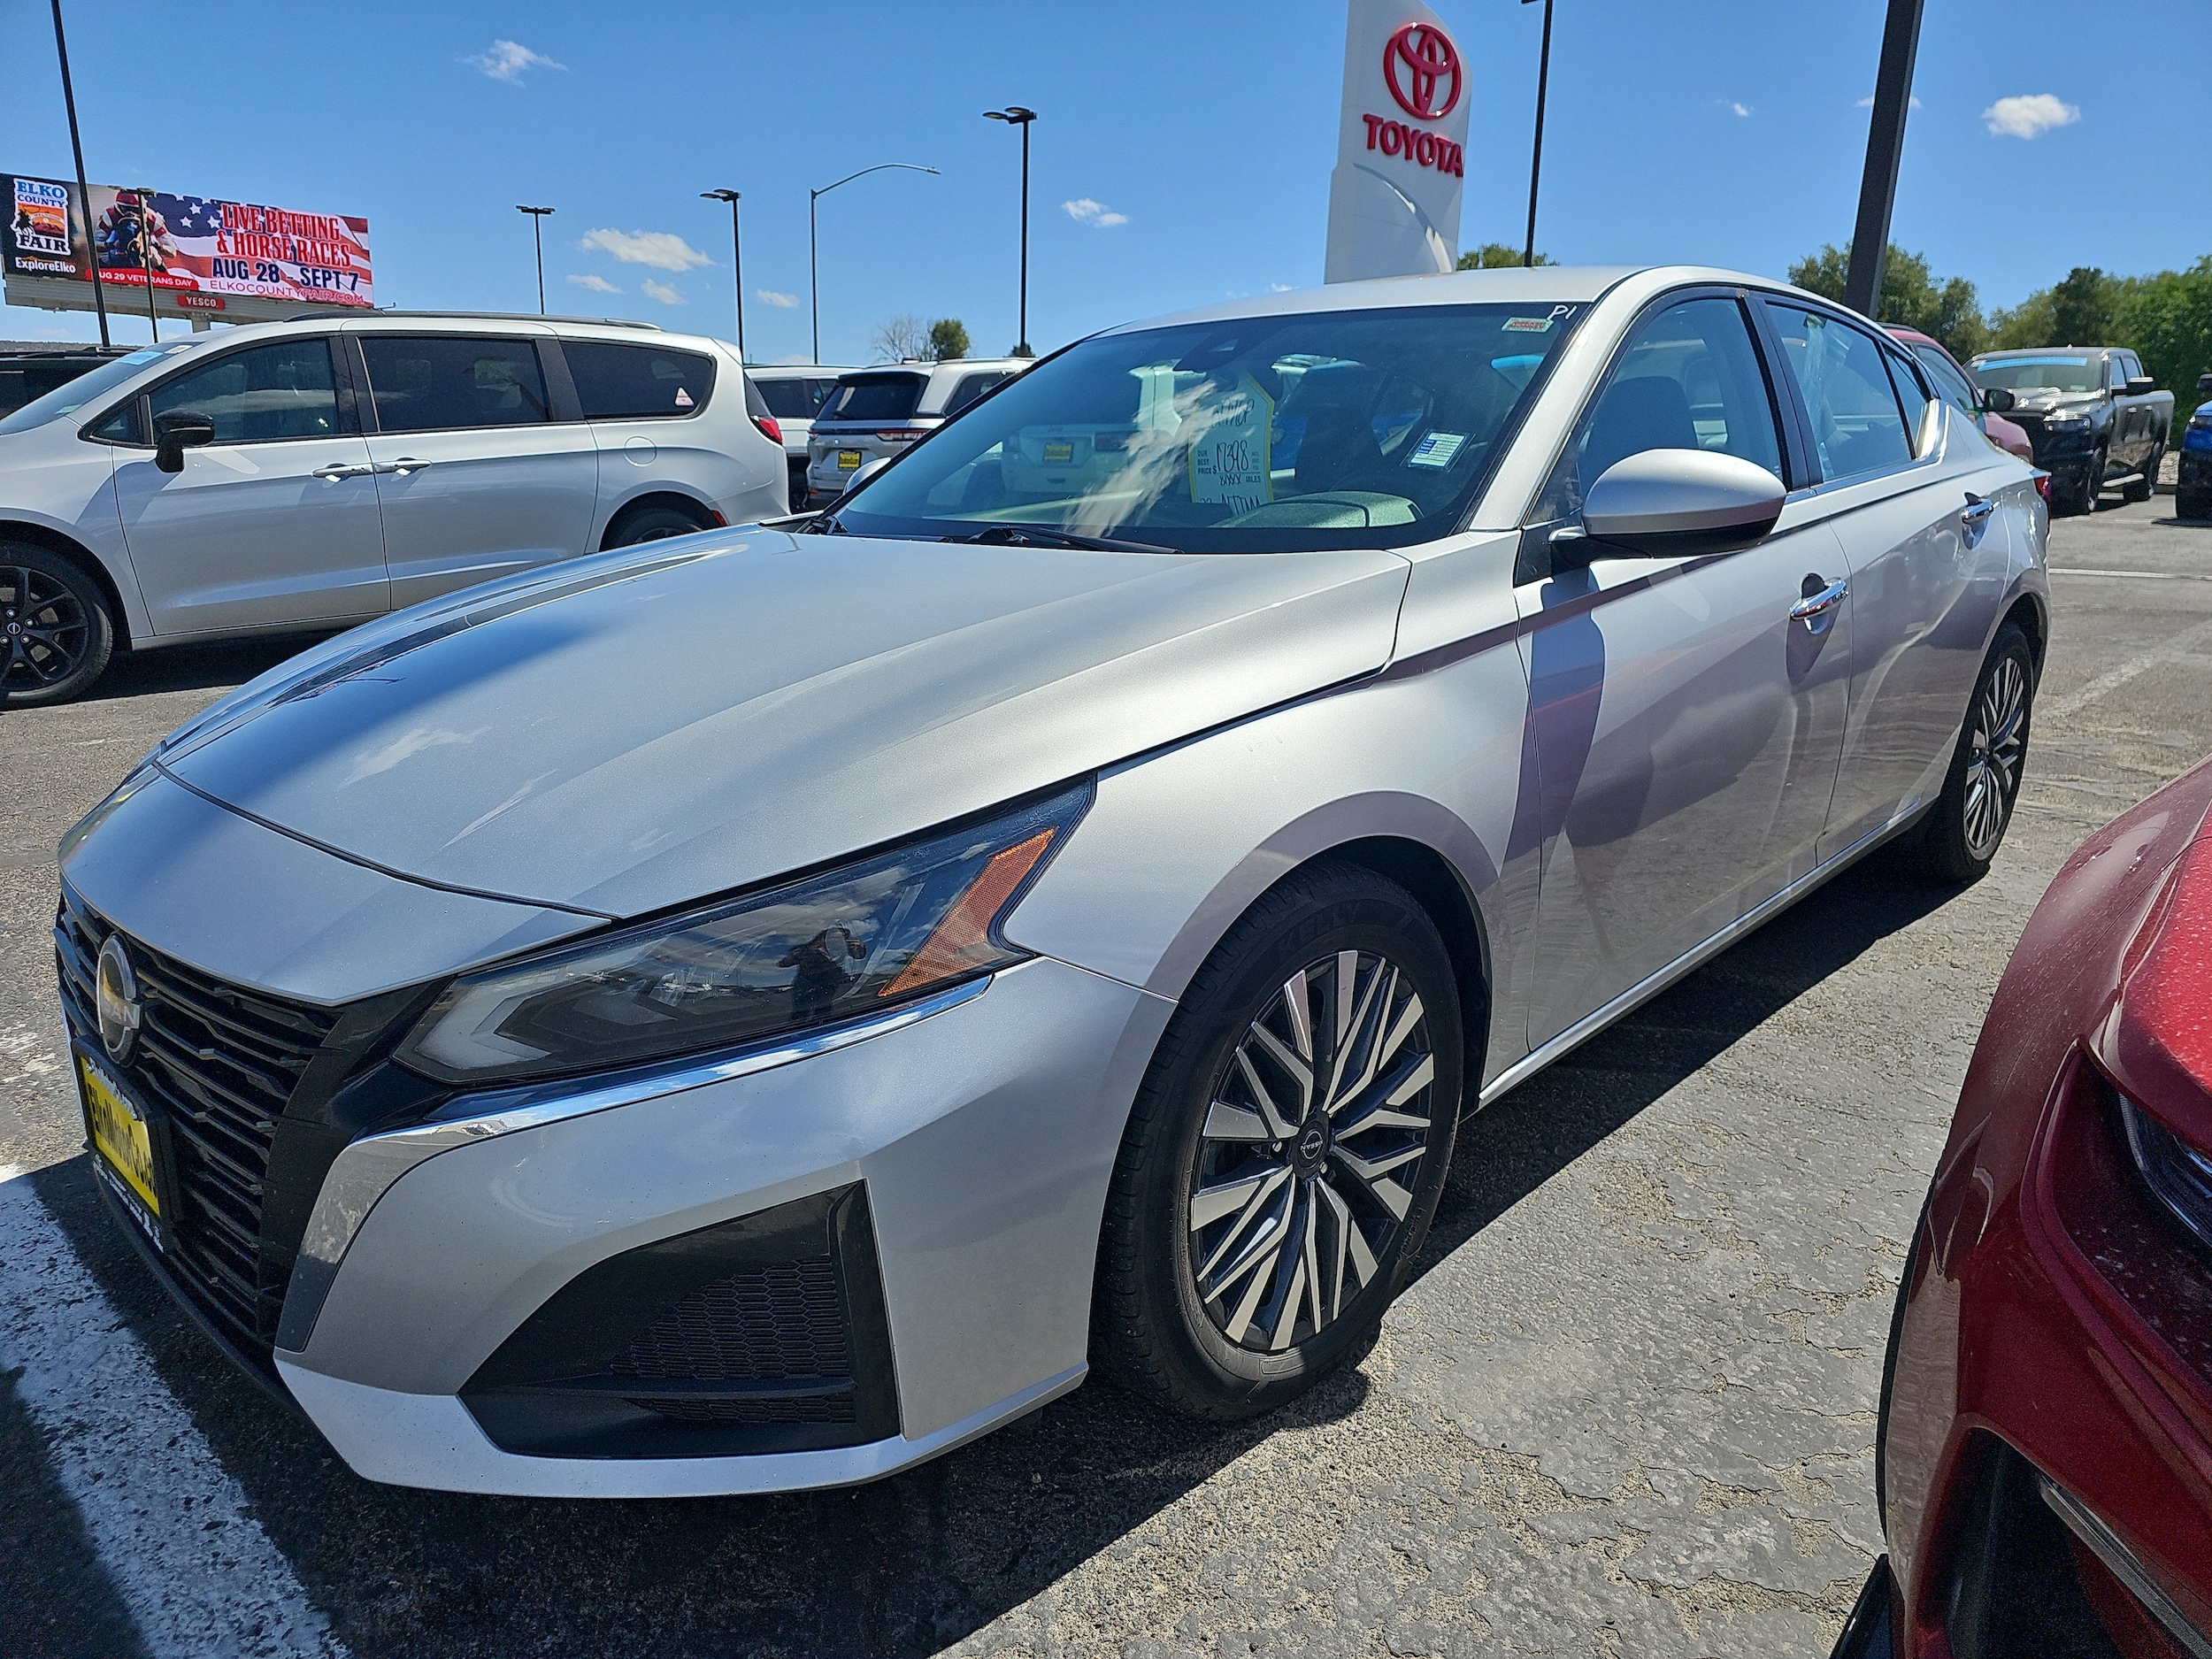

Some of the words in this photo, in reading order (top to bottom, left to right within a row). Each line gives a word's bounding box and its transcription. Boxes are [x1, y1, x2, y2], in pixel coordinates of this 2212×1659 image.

[1363, 112, 1463, 178] TOYOTA
[16, 180, 65, 199] ELKO
[18, 194, 65, 208] COUNTY
[221, 203, 262, 232] LIVE
[265, 210, 341, 241] BETTING
[19, 234, 68, 253] FAIR
[216, 230, 229, 255] &
[233, 232, 292, 262] HORSE
[297, 239, 351, 267] RACES
[15, 257, 76, 273] ExploreElko
[212, 257, 250, 280] AUG
[256, 263, 280, 283] 28
[299, 266, 342, 290] SEPT
[348, 272, 358, 291] 7
[114, 273, 126, 281] 29
[174, 279, 193, 288] DAY
[210, 280, 365, 303] ELKOCOUNTYFAIR.COM
[186, 296, 217, 308] YESCO
[1245, 475, 1262, 484] MILES
[1300, 1138, 1324, 1151] NISSAN
